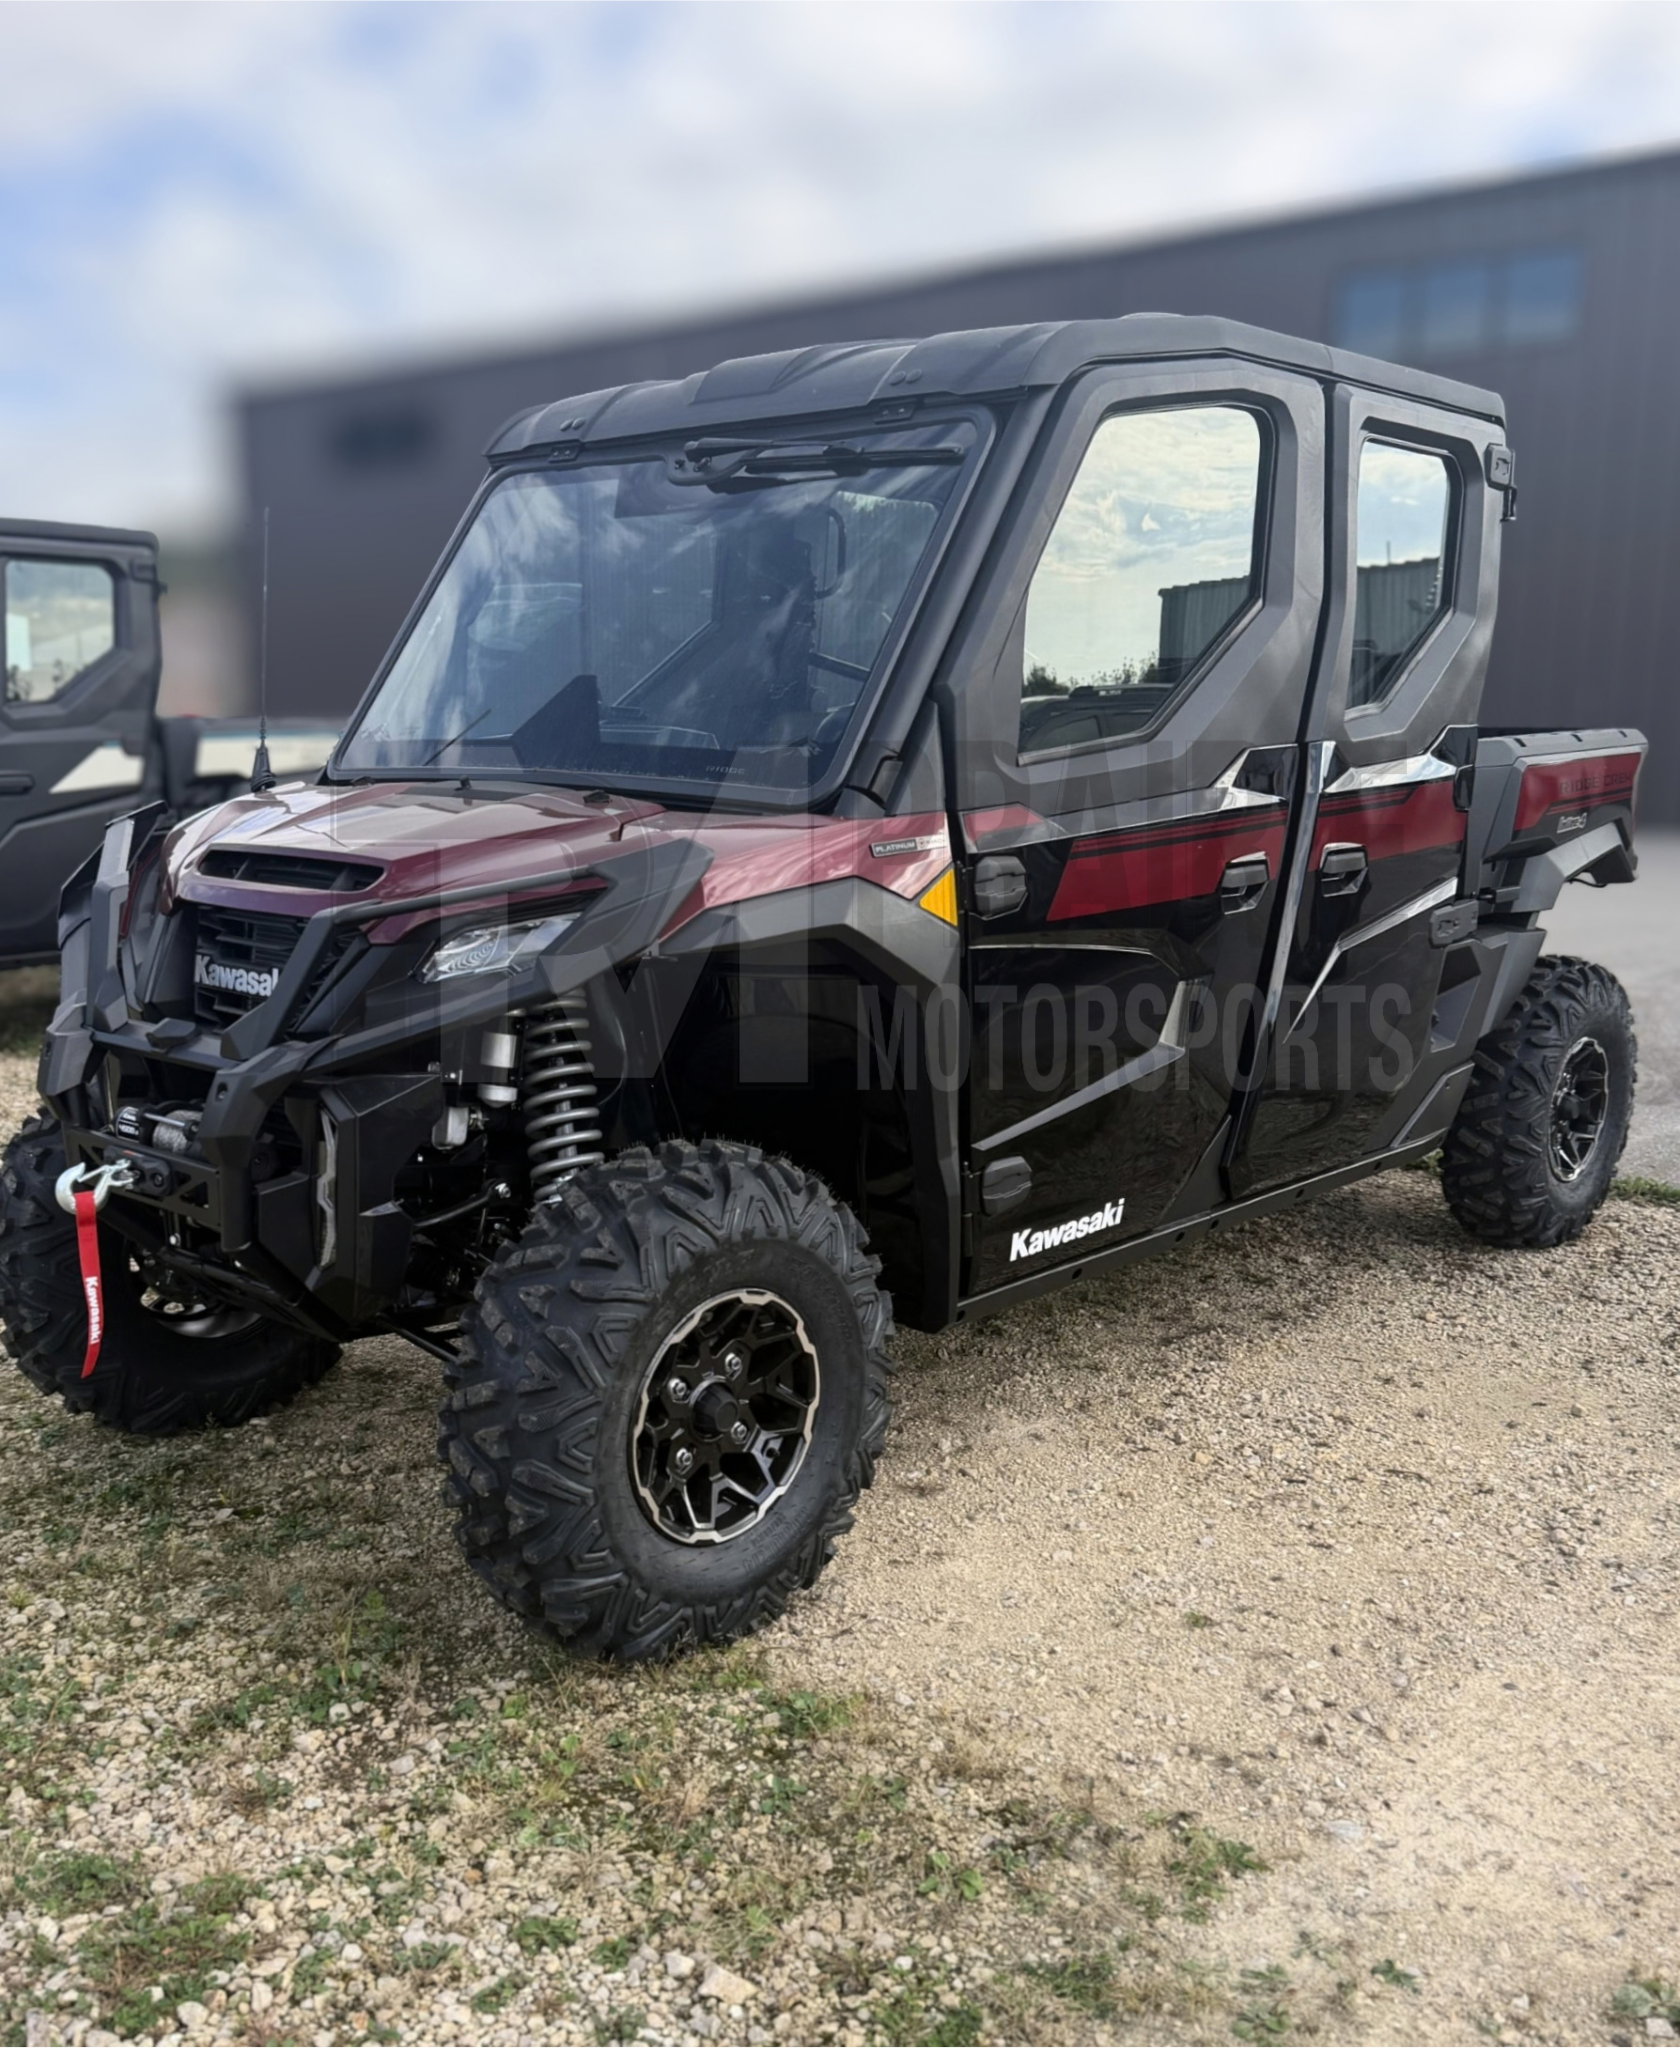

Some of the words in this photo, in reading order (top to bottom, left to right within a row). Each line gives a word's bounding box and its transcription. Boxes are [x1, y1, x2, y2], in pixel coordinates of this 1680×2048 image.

[1559, 776, 1600, 794] RIDGE
[875, 841, 915, 853] PLATINUM
[1009, 1198, 1126, 1262] Kawasaki
[85, 1276, 101, 1345] Kawasaki
